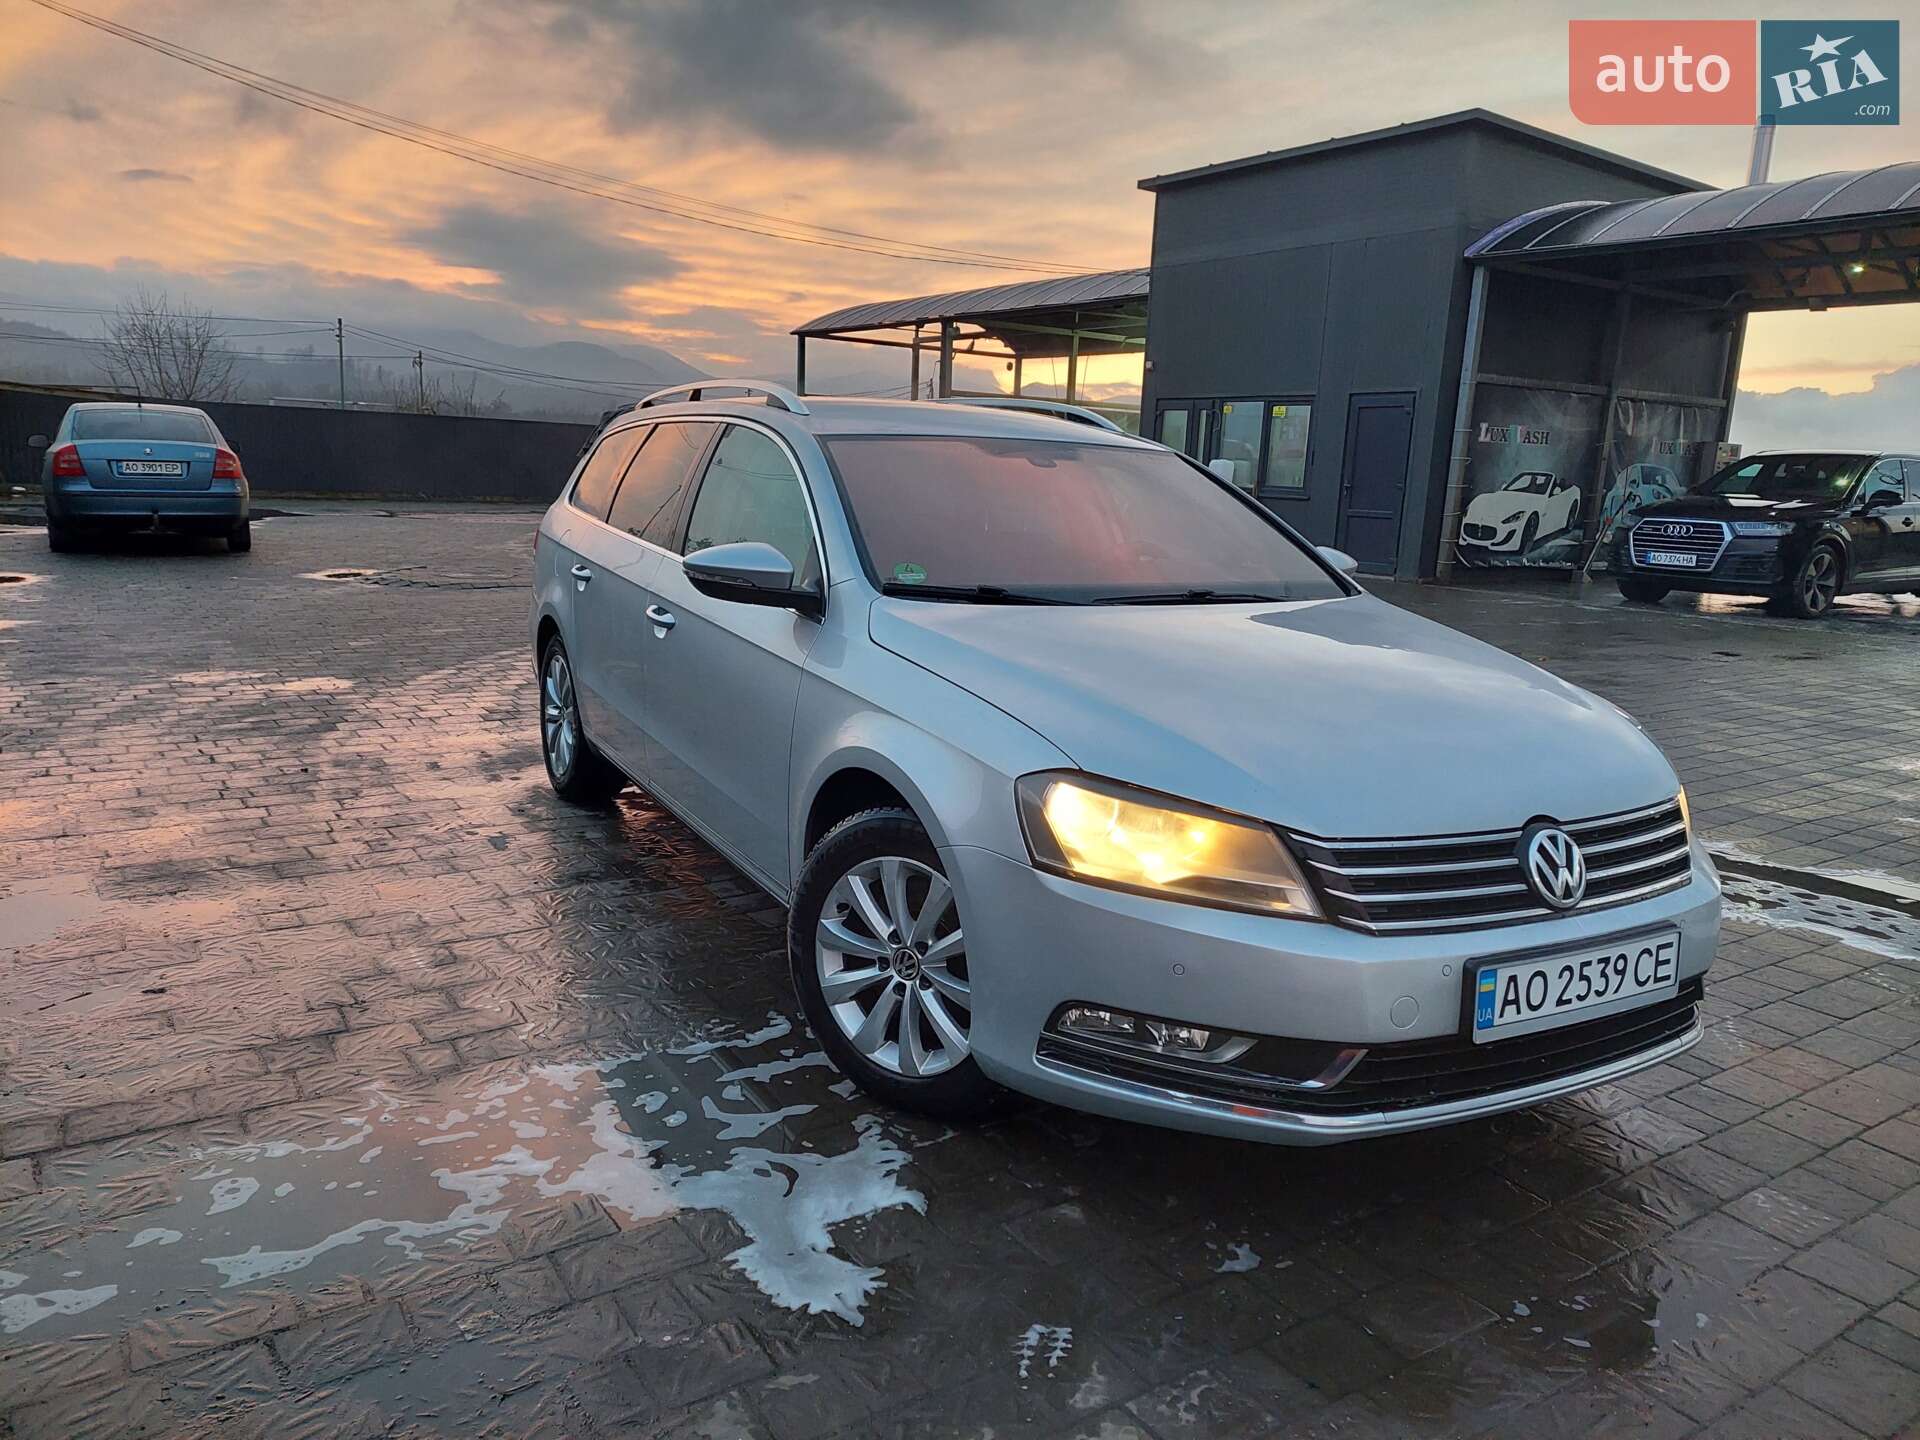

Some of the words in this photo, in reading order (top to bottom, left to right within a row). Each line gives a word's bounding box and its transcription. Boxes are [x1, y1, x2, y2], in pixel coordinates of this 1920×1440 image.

[1478, 422, 1510, 443] LUX
[124, 463, 139, 473] AO
[140, 463, 164, 473] 3901
[165, 463, 180, 474] EP
[1498, 969, 1549, 1019] AO
[1555, 952, 1629, 1008] 2539
[1634, 940, 1675, 988] CE
[1477, 1007, 1493, 1022] UA
